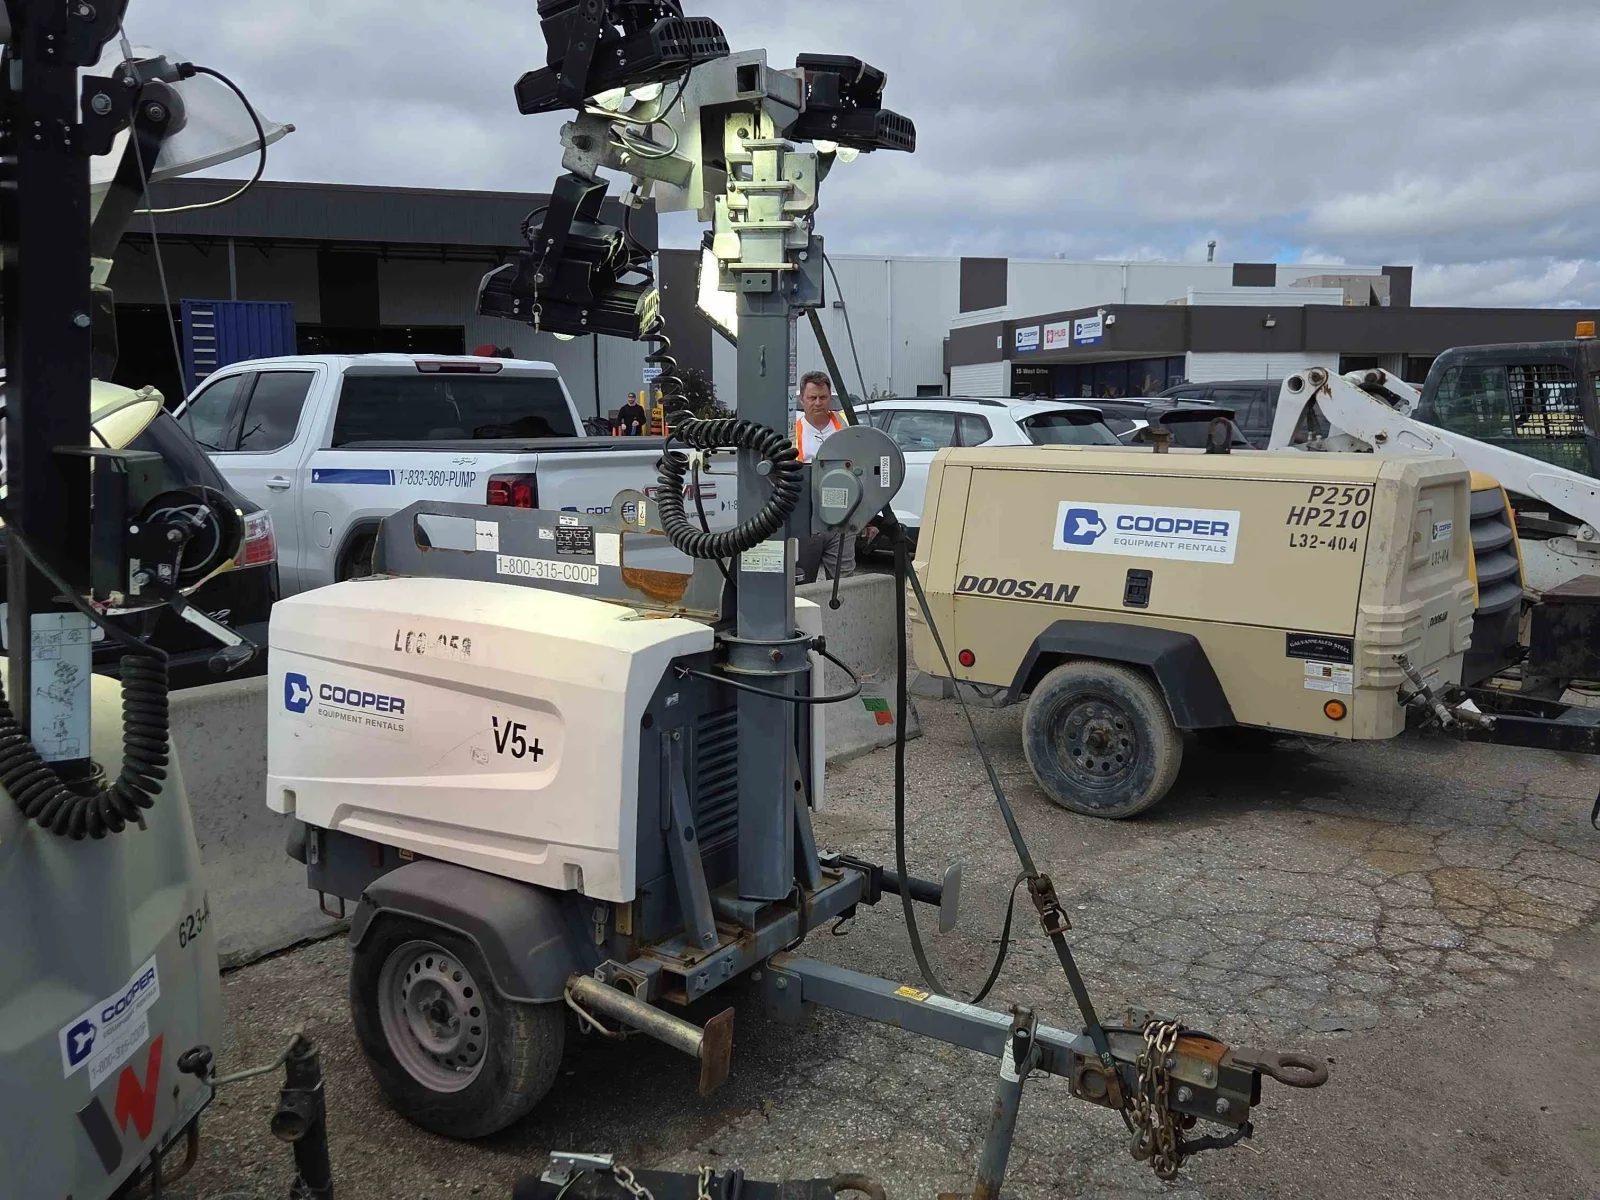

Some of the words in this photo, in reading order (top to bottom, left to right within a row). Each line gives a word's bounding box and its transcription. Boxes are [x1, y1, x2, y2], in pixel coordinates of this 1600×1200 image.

[1054, 329, 1066, 337] HUB
[399, 469, 477, 488] 1-833-360-PUMP
[1307, 485, 1371, 506] P250
[1116, 515, 1230, 537] COOPER
[1286, 506, 1367, 529] HP210
[1113, 537, 1175, 550] EQUIPMENT
[1177, 543, 1227, 553] RENTALS
[1289, 533, 1358, 552] L32-404
[498, 557, 598, 585] 1-800-315-COOP
[957, 575, 1080, 603] DOOSAN
[1333, 643, 1350, 654] STEEL
[319, 683, 406, 715] COOPER
[318, 708, 363, 724] EQUIPMENT
[365, 718, 404, 732] RENTALS
[492, 715, 544, 763] V5+
[102, 966, 155, 1024] COOPER
